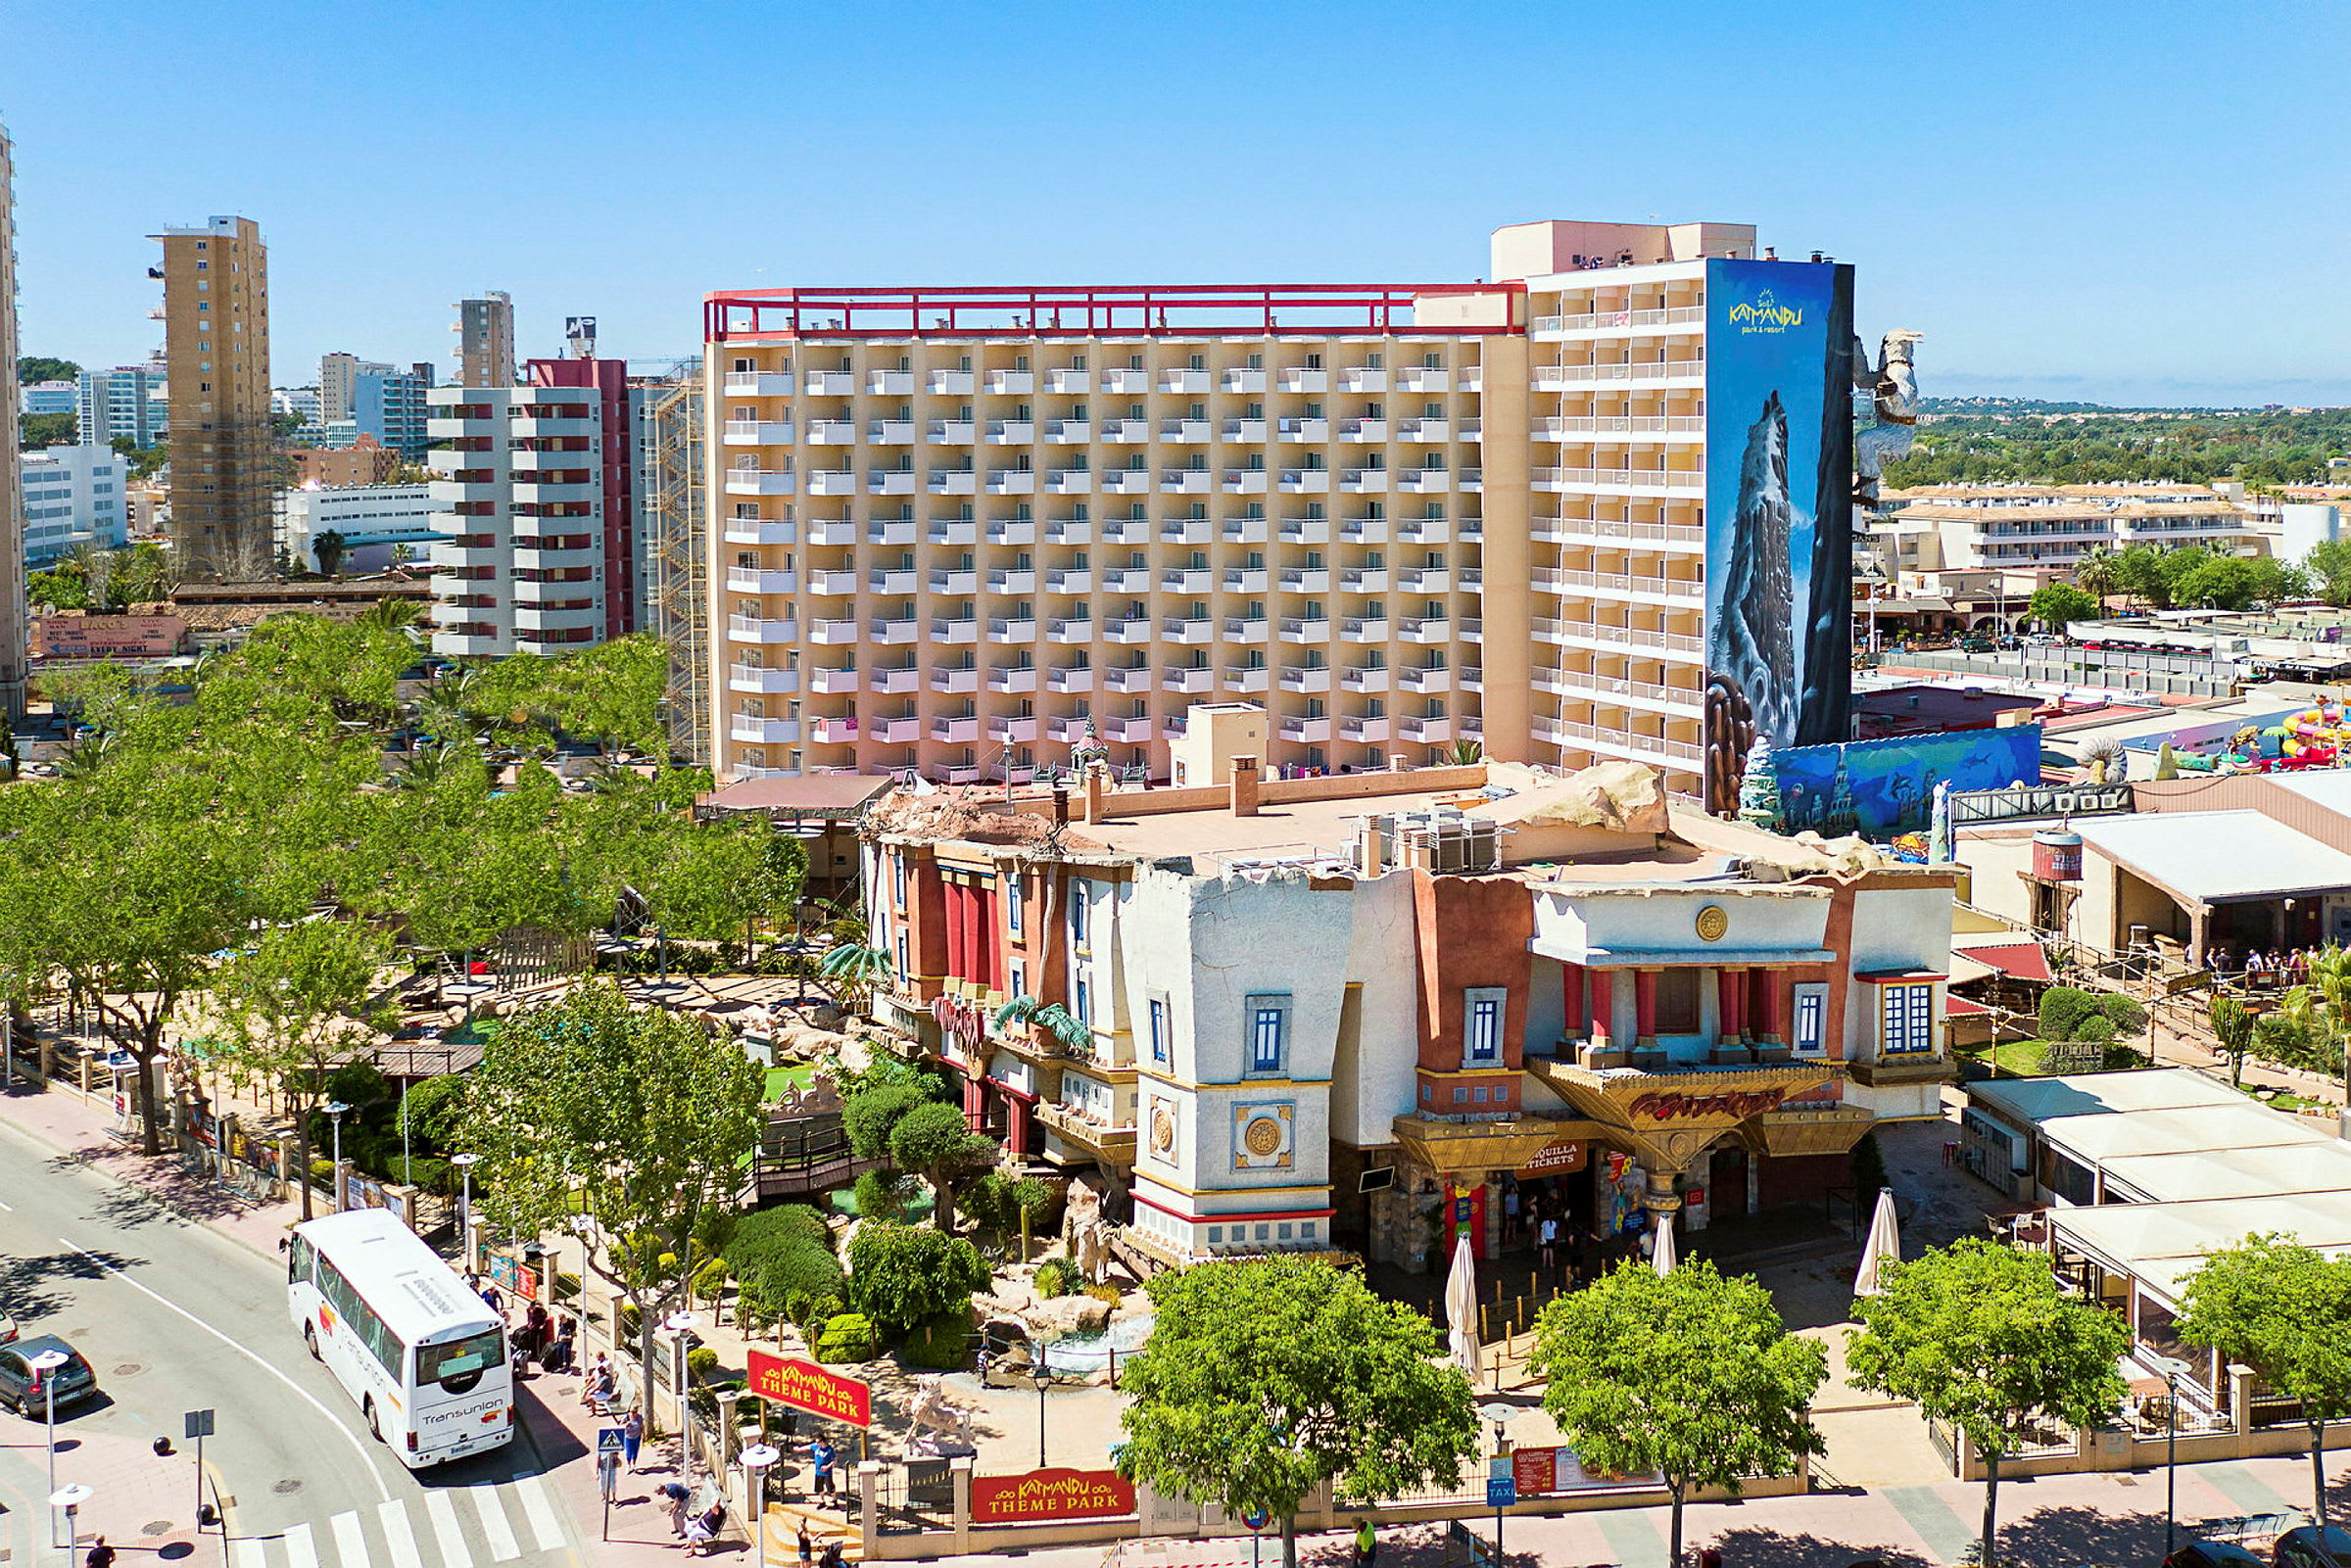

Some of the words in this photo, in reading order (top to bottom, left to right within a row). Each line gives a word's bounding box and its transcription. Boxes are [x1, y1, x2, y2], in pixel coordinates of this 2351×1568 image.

[1729, 304, 1802, 326] KATMANDU
[1742, 327, 1757, 336] park
[1528, 1155, 1574, 1168] TICKETS
[782, 1365, 836, 1396] KATMANDU
[760, 1376, 812, 1402] THEME
[817, 1395, 858, 1417] PARK
[422, 1398, 504, 1425] Transunion
[1019, 1477, 1089, 1499] KATMANDU
[1489, 1487, 1514, 1497] TAXI
[988, 1498, 1057, 1513] THEME
[1067, 1495, 1119, 1509] PARK
